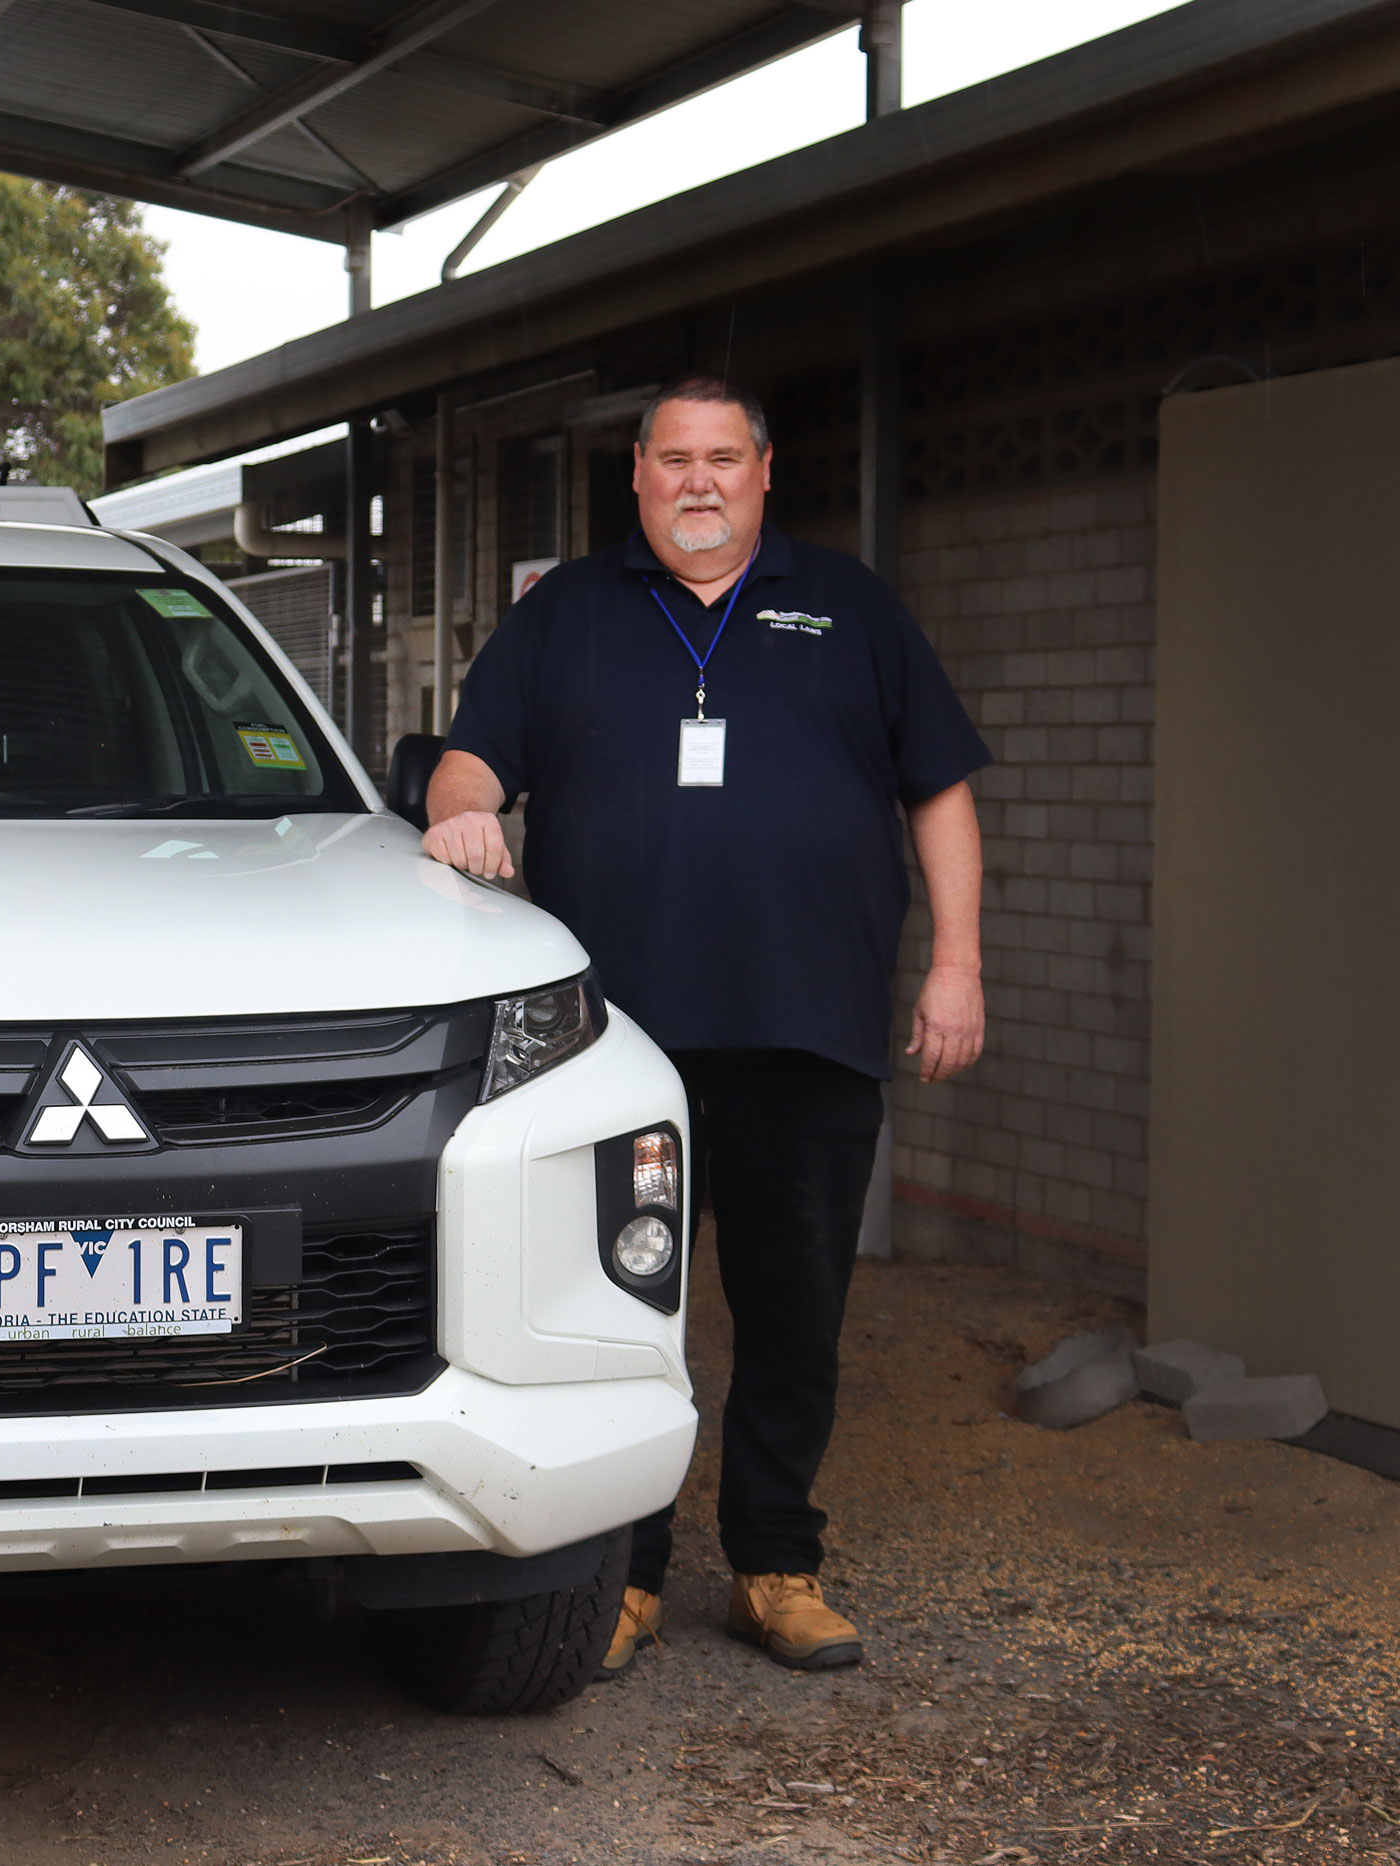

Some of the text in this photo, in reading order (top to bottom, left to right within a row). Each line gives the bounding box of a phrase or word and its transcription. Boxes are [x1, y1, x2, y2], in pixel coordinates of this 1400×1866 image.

[770, 621, 822, 636] LOCAL LAWS
[58, 1219, 102, 1231] RURAL
[105, 1218, 135, 1230] CITY
[137, 1216, 196, 1229] COUNCIL
[76, 1240, 107, 1255] VIC
[129, 1238, 231, 1304] 1RE
[47, 1312, 78, 1326] THE
[84, 1309, 175, 1324] EDUCATION
[181, 1307, 227, 1321] STATE
[8, 1322, 182, 1340] urban rural balance
